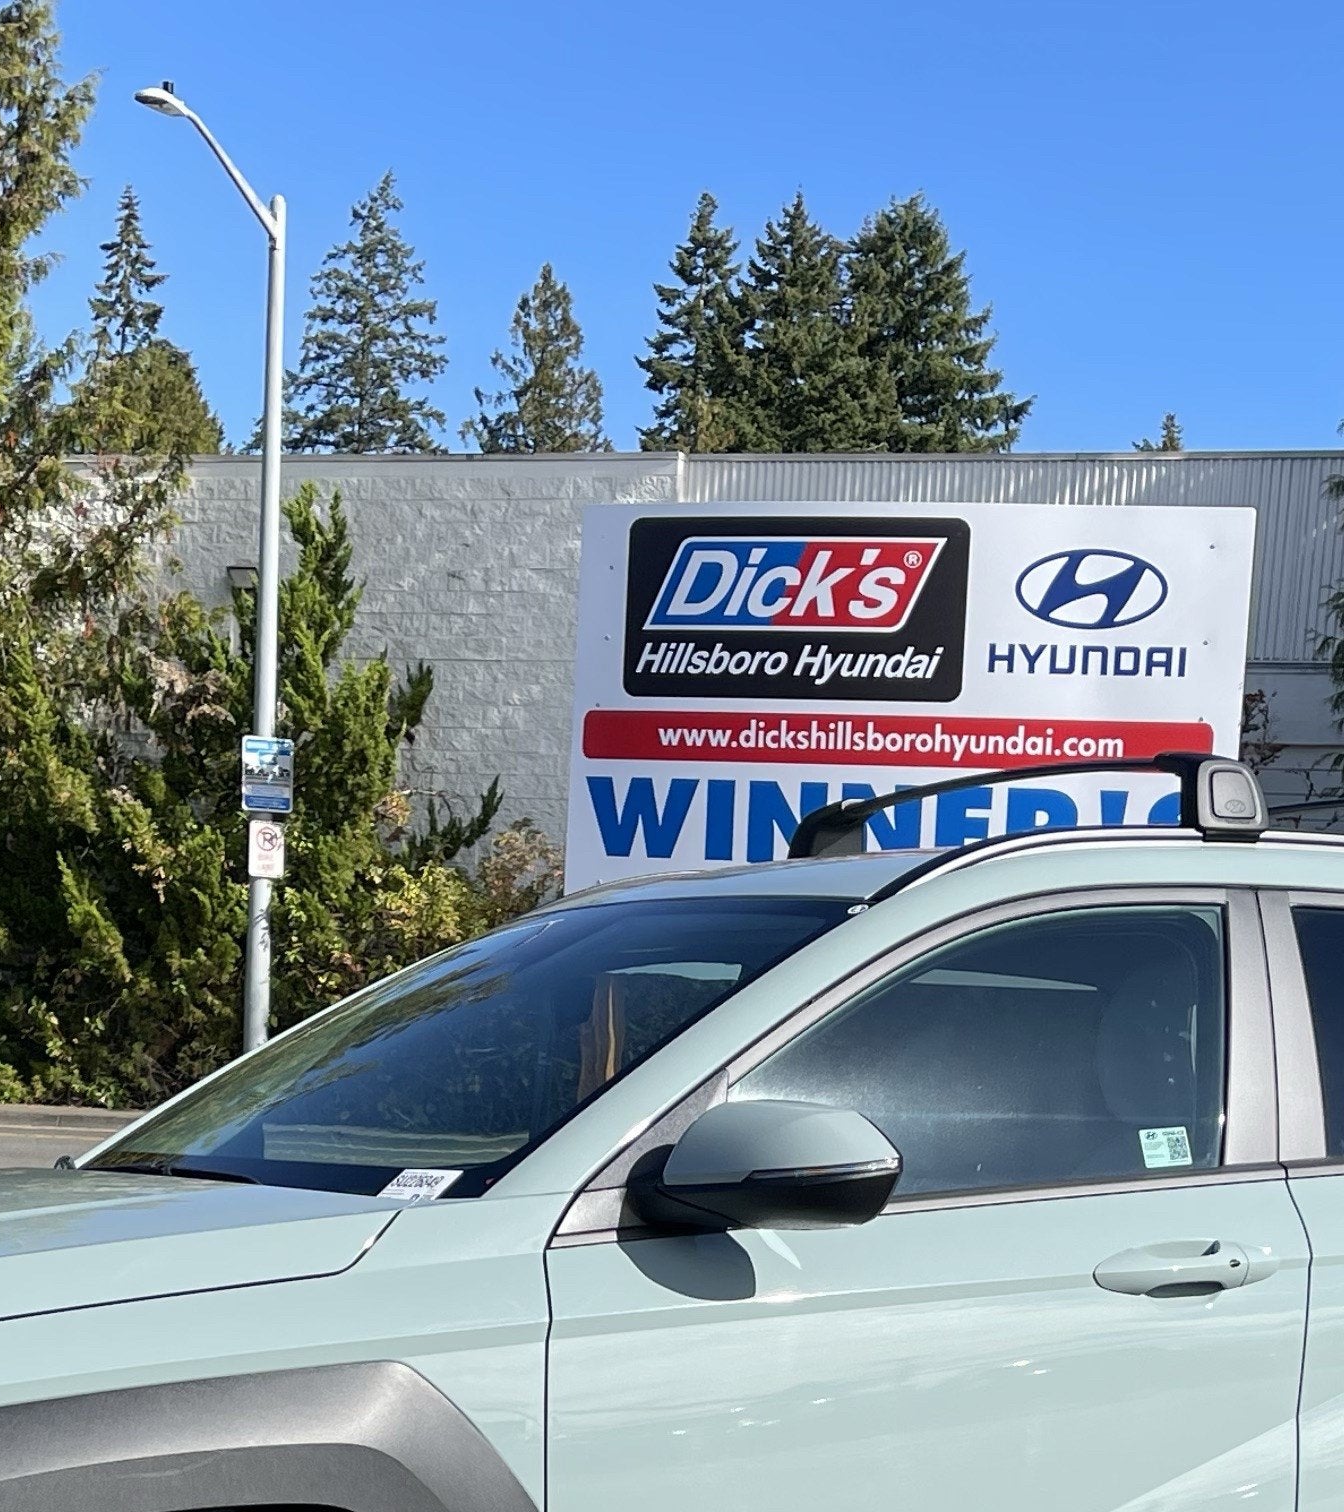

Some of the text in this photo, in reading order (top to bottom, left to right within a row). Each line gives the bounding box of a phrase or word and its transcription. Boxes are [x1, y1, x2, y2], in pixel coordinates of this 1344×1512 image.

[667, 548, 907, 619] Dick's
[635, 641, 943, 683] Hillsboro Hyundai
[989, 643, 1187, 678] HYUNDAI
[657, 719, 1125, 762] www.dickshillsborohyundai.com
